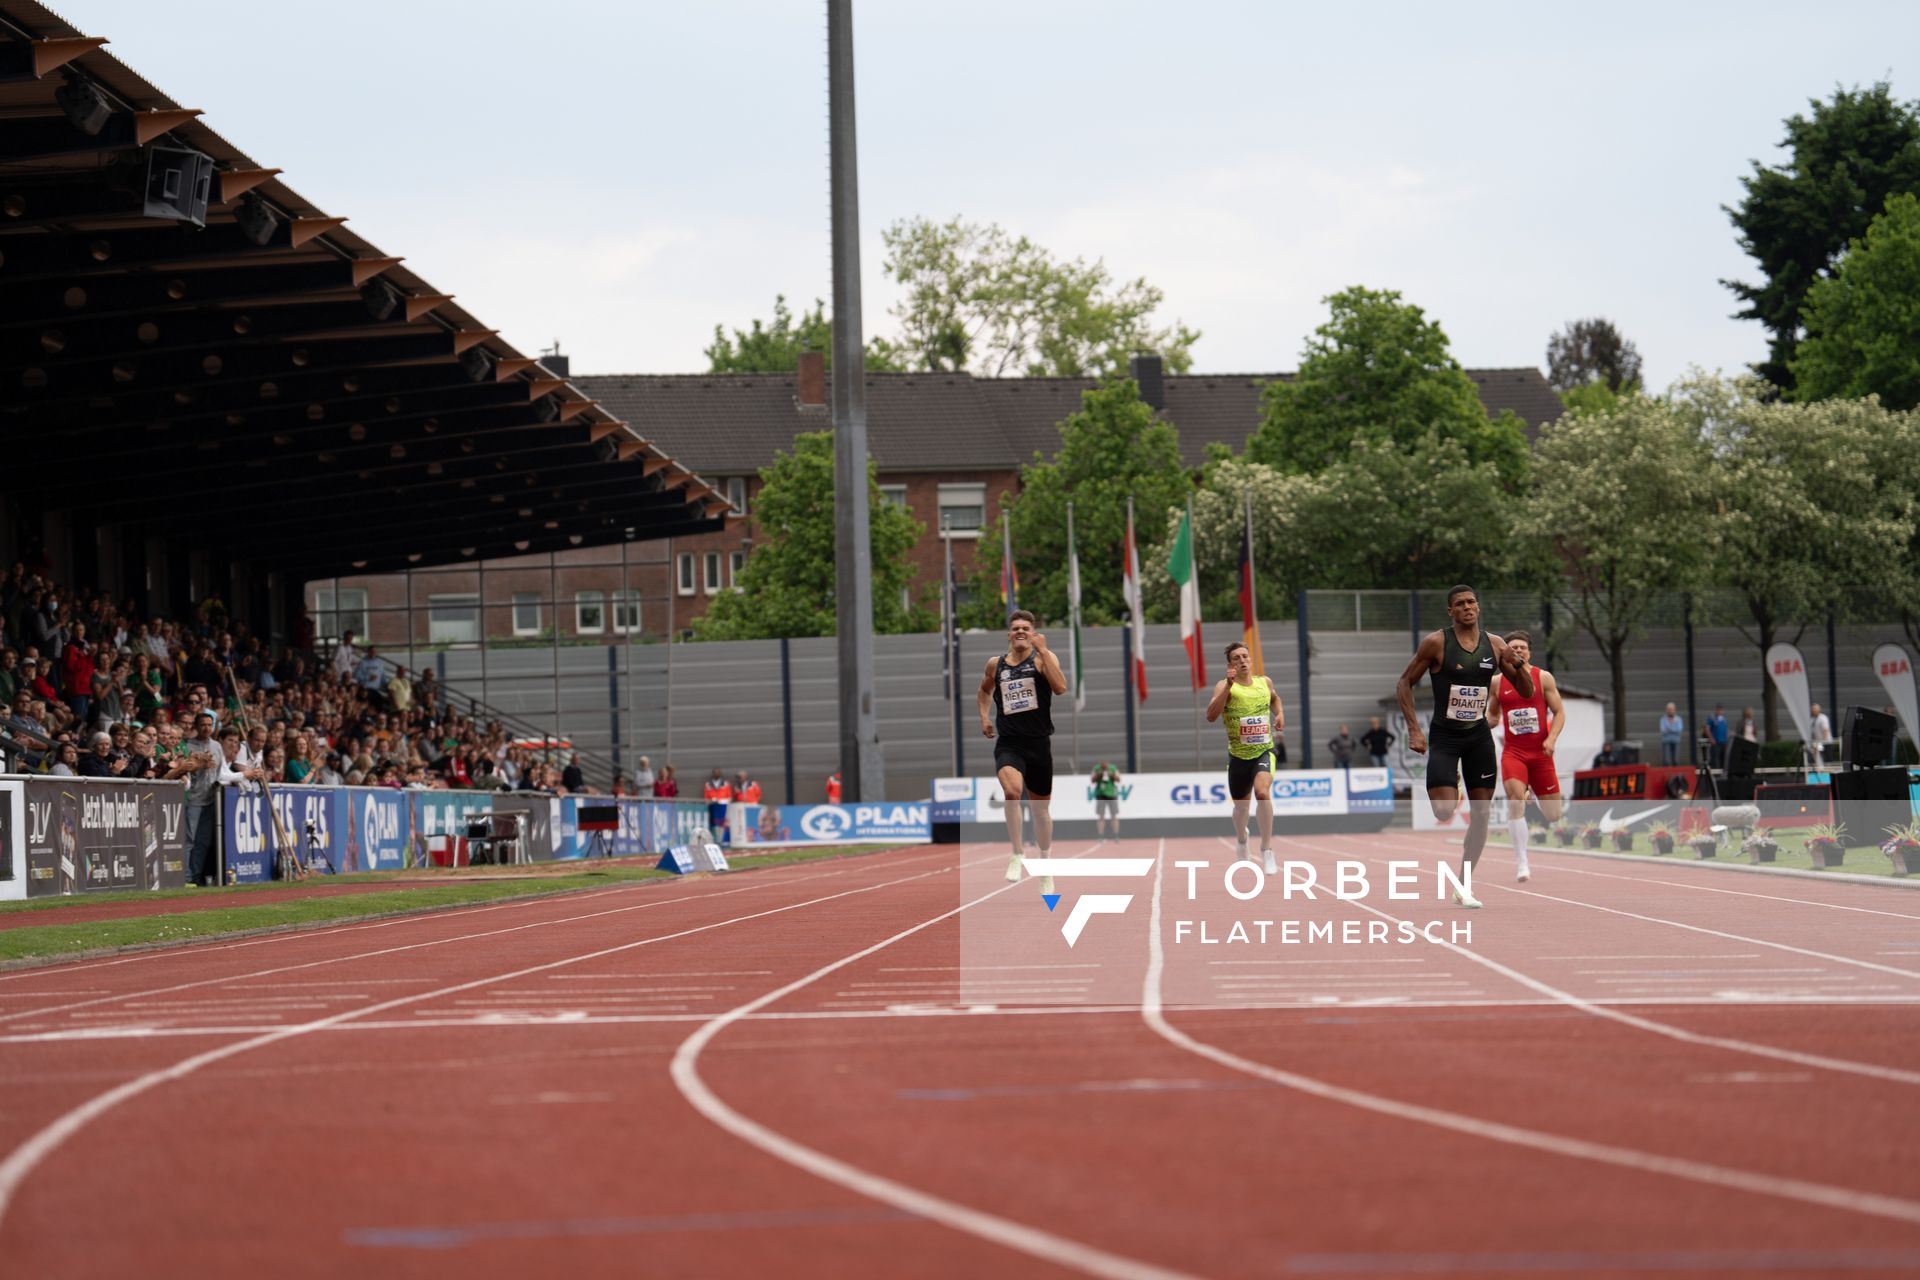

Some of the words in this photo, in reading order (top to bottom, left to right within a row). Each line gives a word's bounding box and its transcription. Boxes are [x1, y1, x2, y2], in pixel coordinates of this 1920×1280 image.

[1008, 681, 1023, 690] GLS
[1005, 689, 1033, 701] MEYER
[1460, 688, 1479, 697] GLS
[1451, 697, 1485, 708] DIAKITE
[1295, 779, 1330, 792] PLAN
[1170, 784, 1227, 805] GLS
[81, 793, 101, 828] Jetzt
[101, 793, 115, 838] App
[114, 791, 139, 828] laden!
[379, 802, 399, 840] PLAN
[855, 806, 928, 826] PLAN
